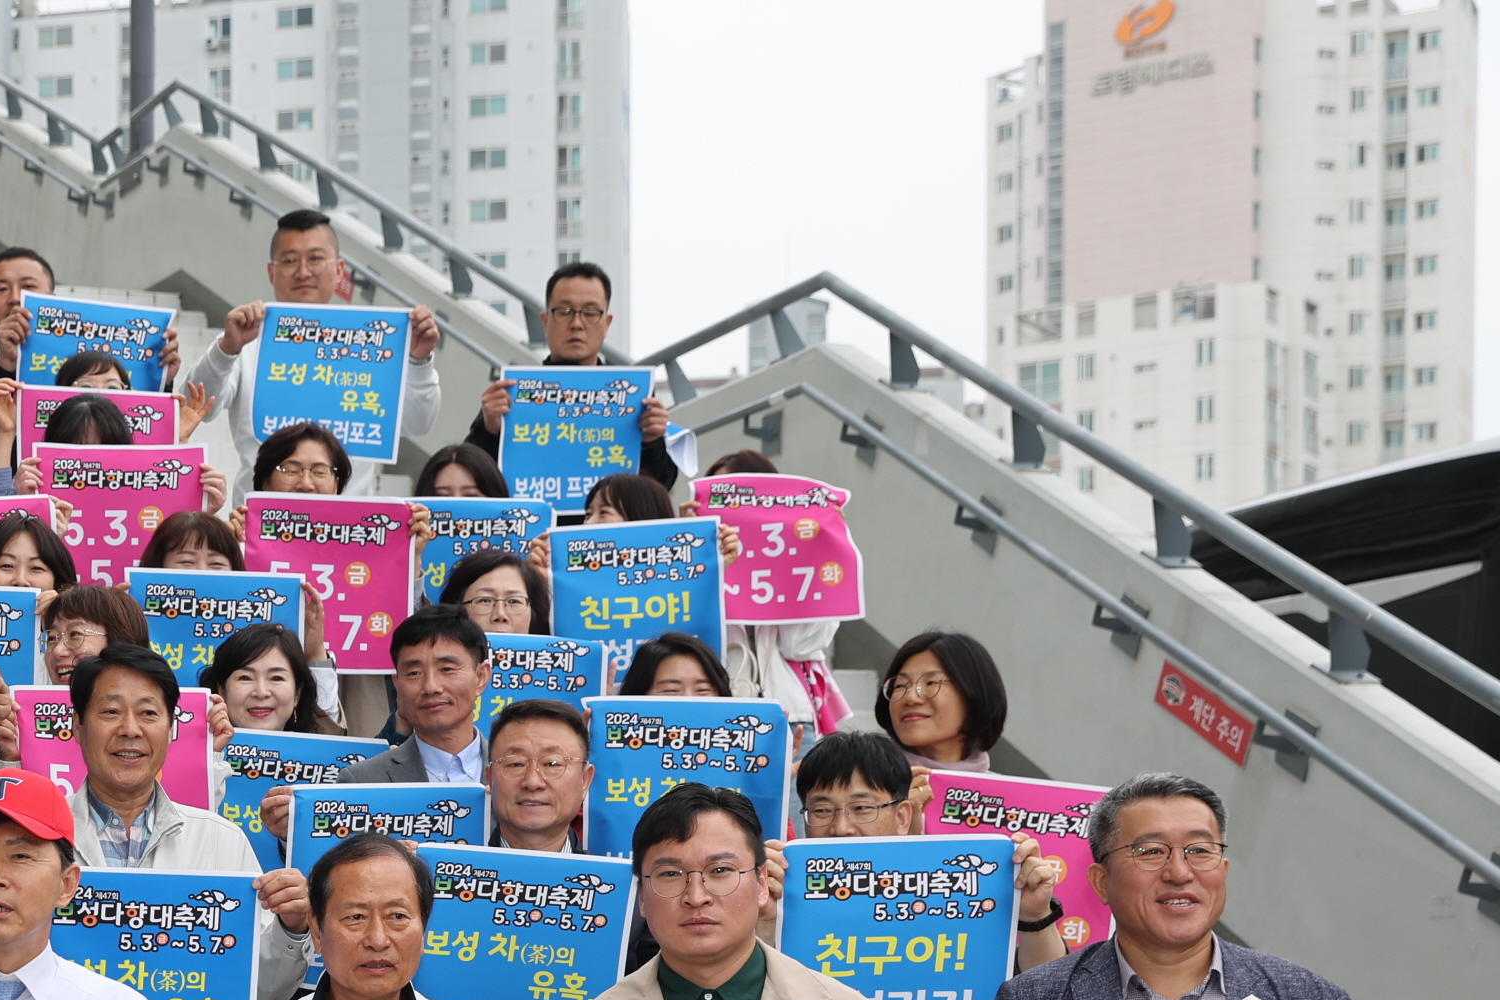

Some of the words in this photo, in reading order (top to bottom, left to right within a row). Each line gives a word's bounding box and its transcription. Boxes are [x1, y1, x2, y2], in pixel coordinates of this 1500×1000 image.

[35, 318, 145, 346] 보성다향대축제
[275, 326, 384, 347] 보성다향대축제
[269, 363, 307, 385] 보성
[341, 390, 385, 416] 유혹,
[513, 424, 550, 446] 보성
[54, 459, 81, 469] 2024
[52, 470, 178, 491] 보성다향대축제
[513, 476, 562, 500] 보성의
[262, 510, 289, 520] 2024
[259, 521, 385, 545] 보성다향대축제
[567, 545, 692, 573] 보성다향대축제
[147, 585, 174, 596] 2024
[144, 597, 272, 622] 보성다향대축제
[580, 591, 691, 630] 친구야!
[606, 713, 638, 725] 2024
[1188, 694, 1216, 733] 계단
[1216, 715, 1245, 754] 주의
[602, 725, 754, 751] 보성다향대축제
[228, 745, 257, 757] 2024
[227, 757, 340, 784] 보성다향대축
[605, 777, 651, 807] 보성
[946, 789, 980, 803] 2024
[315, 801, 346, 813] 2024
[312, 813, 453, 839] 보성다향대축제
[940, 803, 1092, 839] 보성다향대축제
[436, 863, 472, 877] 2024
[807, 858, 844, 873] 2024
[431, 878, 594, 911] 보성다향대축제
[805, 870, 978, 902] 보성다향대축제
[54, 901, 220, 931] 보성다향대축제
[420, 930, 480, 962] 보성
[812, 933, 968, 981] 친구야!
